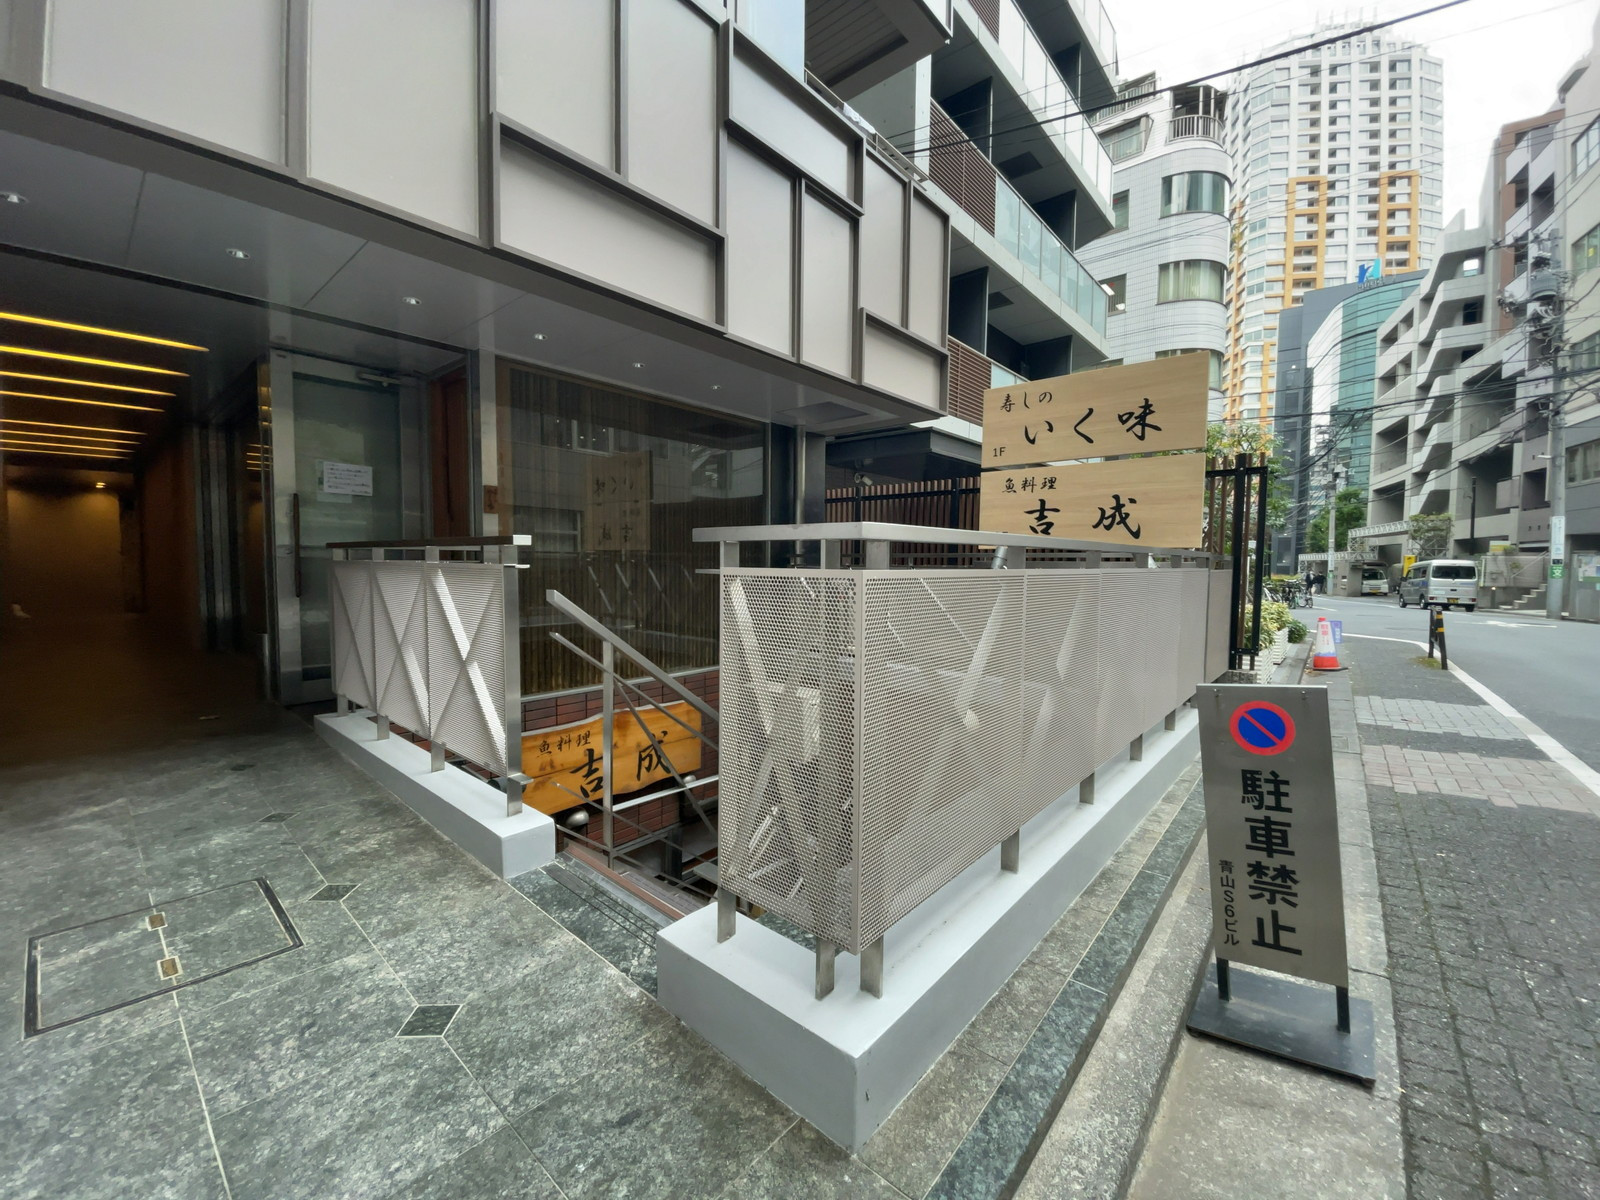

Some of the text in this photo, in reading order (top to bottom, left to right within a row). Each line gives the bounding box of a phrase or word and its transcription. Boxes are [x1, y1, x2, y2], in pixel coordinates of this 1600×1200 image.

[1000, 391, 1053, 412] 寿しの
[1024, 398, 1162, 444] いく味
[992, 446, 1006, 457] 1F
[1001, 476, 1057, 494] 魚料理
[1024, 494, 1141, 539] 吉成
[537, 730, 591, 757] 魚料理
[1240, 768, 1302, 956] 駐車禁止
[1218, 859, 1240, 946] 青山S6ビル
